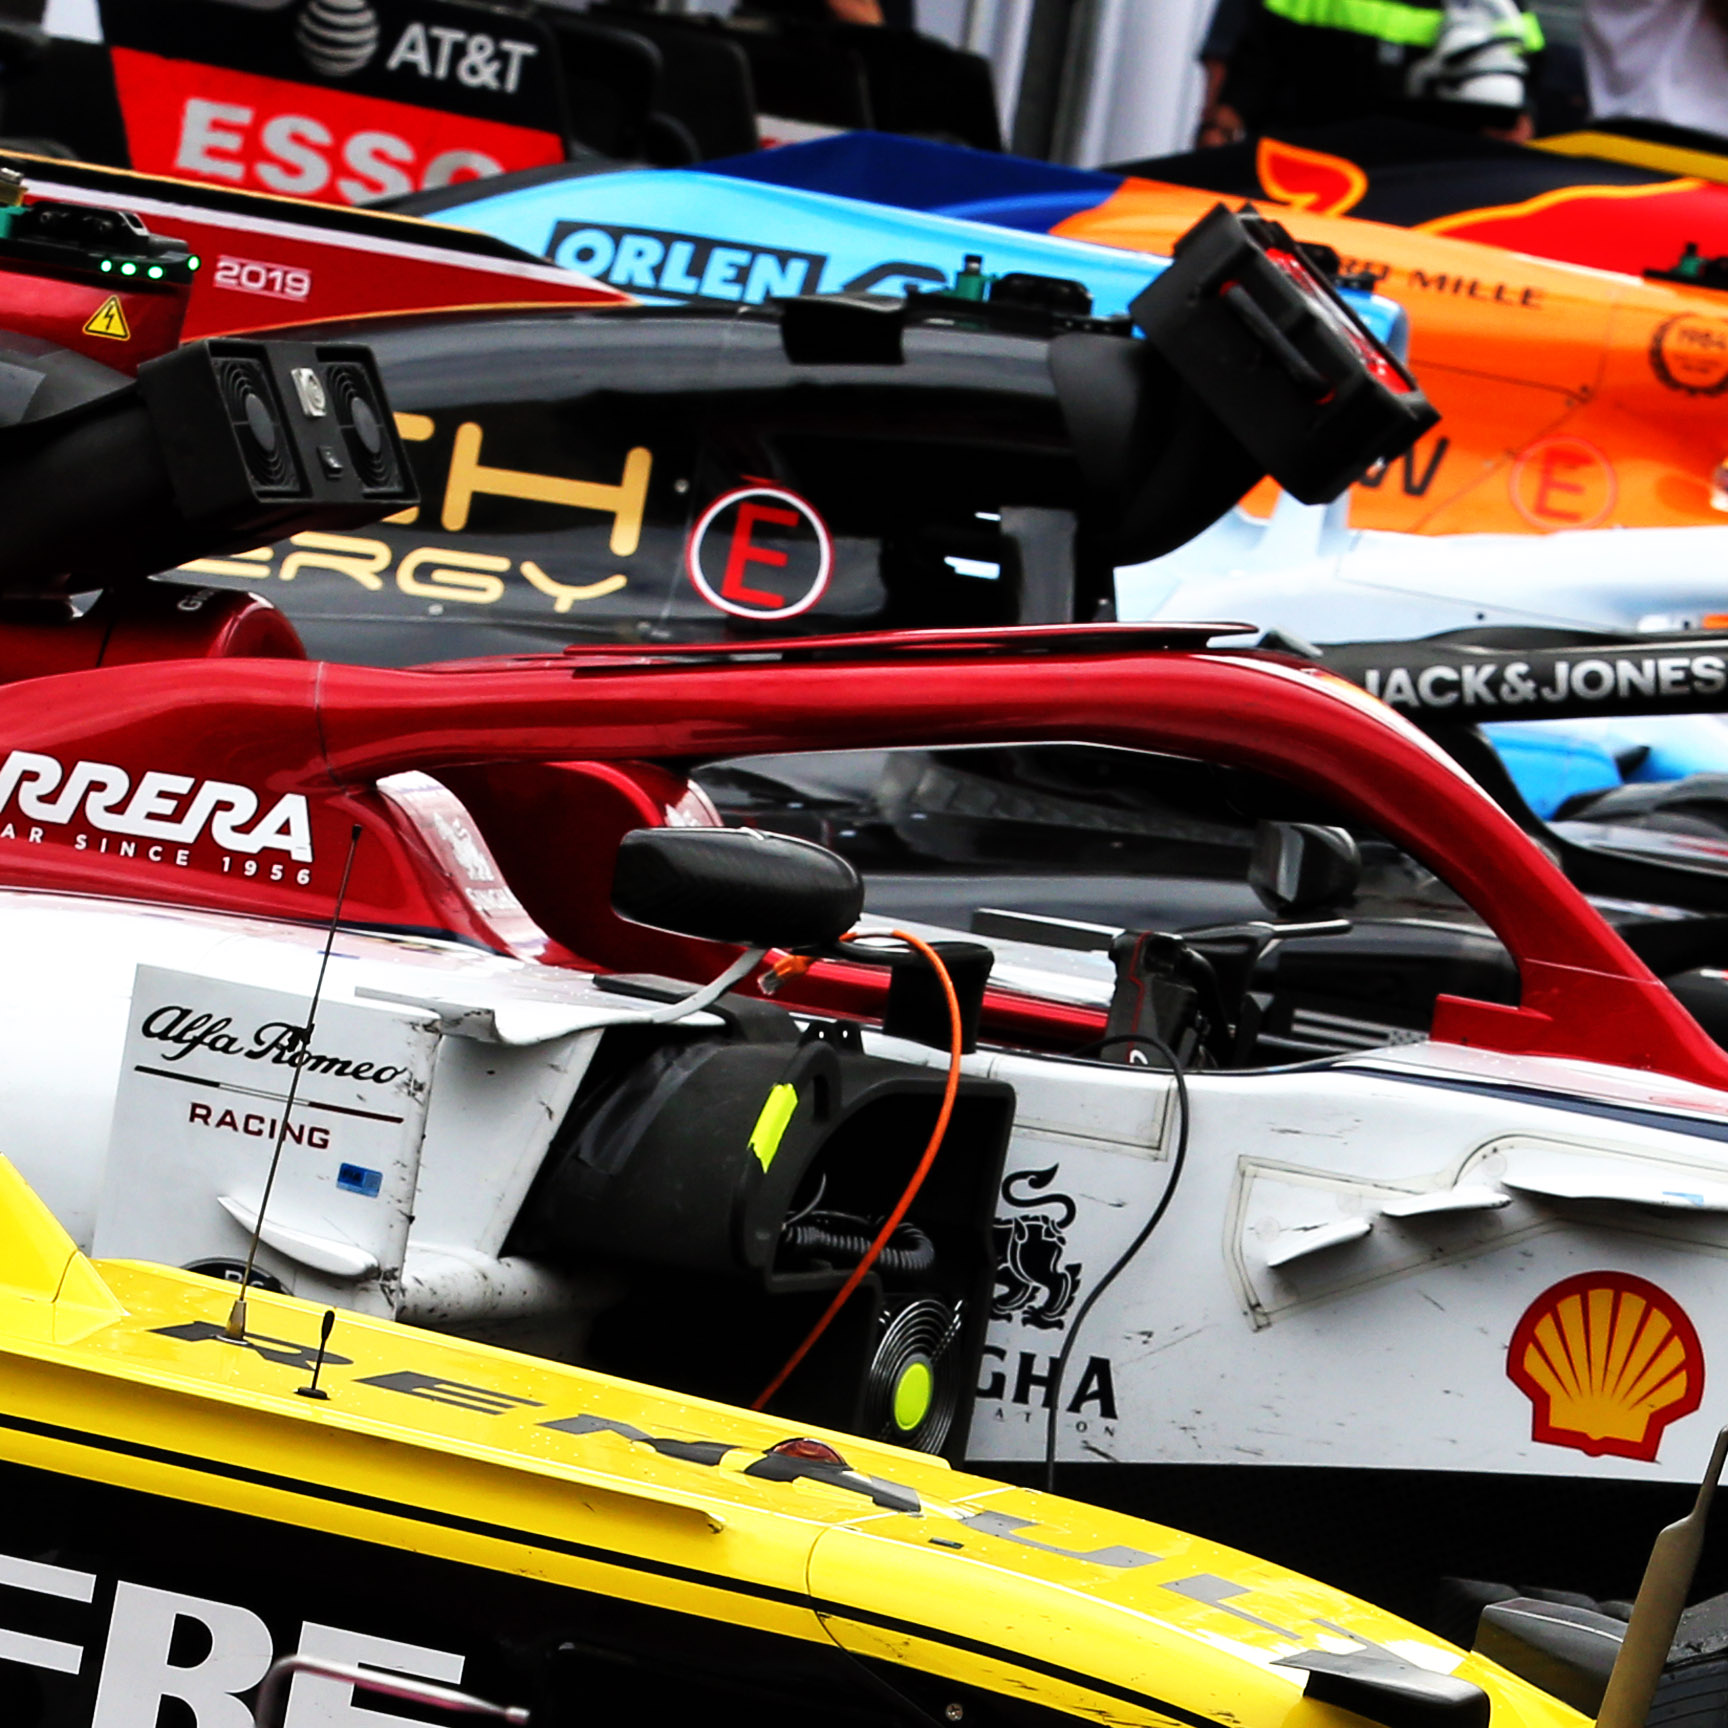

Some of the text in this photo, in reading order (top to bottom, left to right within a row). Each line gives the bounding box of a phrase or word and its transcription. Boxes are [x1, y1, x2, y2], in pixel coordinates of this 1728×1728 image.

[387, 24, 538, 94] AT&T
[215, 259, 311, 299] 2019
[554, 228, 810, 303] ORLEN
[1409, 270, 1544, 308] MILLE
[1533, 445, 1604, 523] E
[720, 502, 799, 609] E
[1364, 655, 1728, 711] JACK&JONES
[75, 834, 190, 867] SINCE
[222, 857, 313, 887] 1956
[140, 1003, 409, 1088] Alfa Romeo
[188, 1100, 332, 1152] RACING
[149, 1320, 1417, 1667] RENAUL
